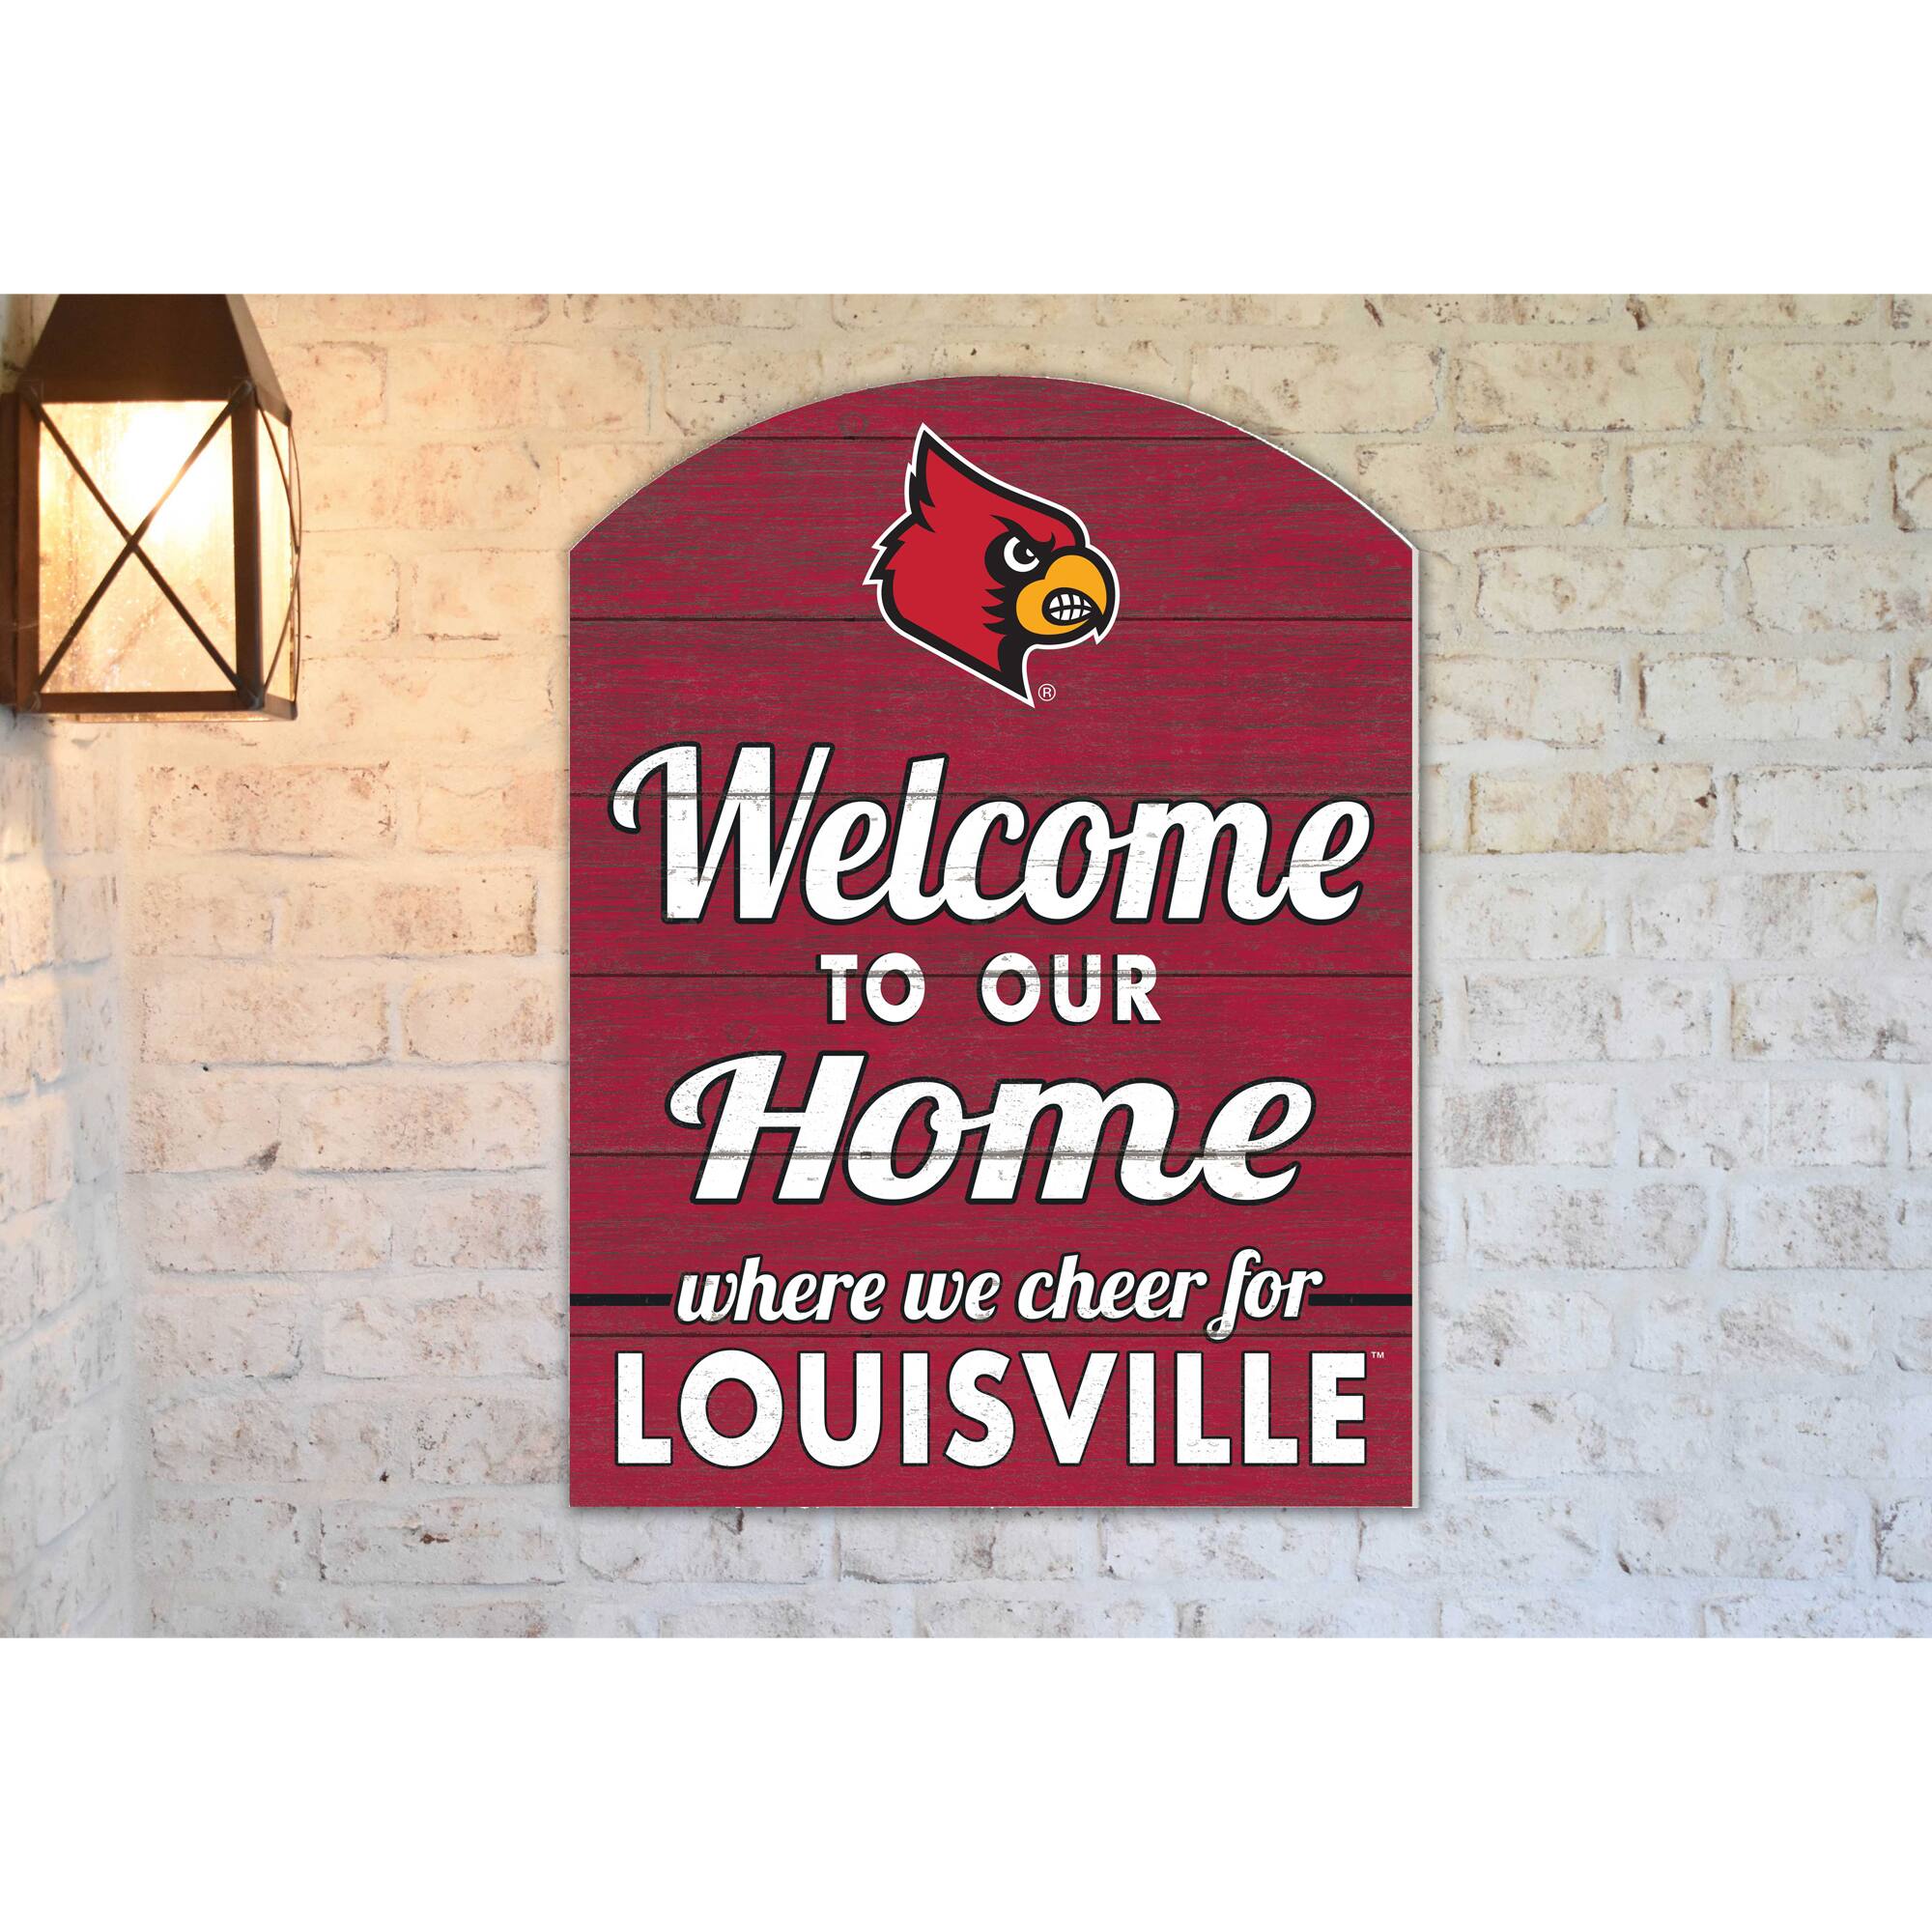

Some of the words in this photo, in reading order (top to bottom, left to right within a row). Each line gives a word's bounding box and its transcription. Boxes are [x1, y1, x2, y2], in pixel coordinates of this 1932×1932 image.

[611, 744, 1372, 923] Welcome
[819, 951, 926, 1025] TO
[980, 951, 1163, 1025] OUR
[667, 1053, 1314, 1204] Home
[676, 1255, 887, 1323] where
[902, 1270, 1002, 1321] we
[1016, 1253, 1208, 1321] cheer
[1205, 1247, 1324, 1339] for
[615, 1349, 1367, 1468] LOUISVILLE
